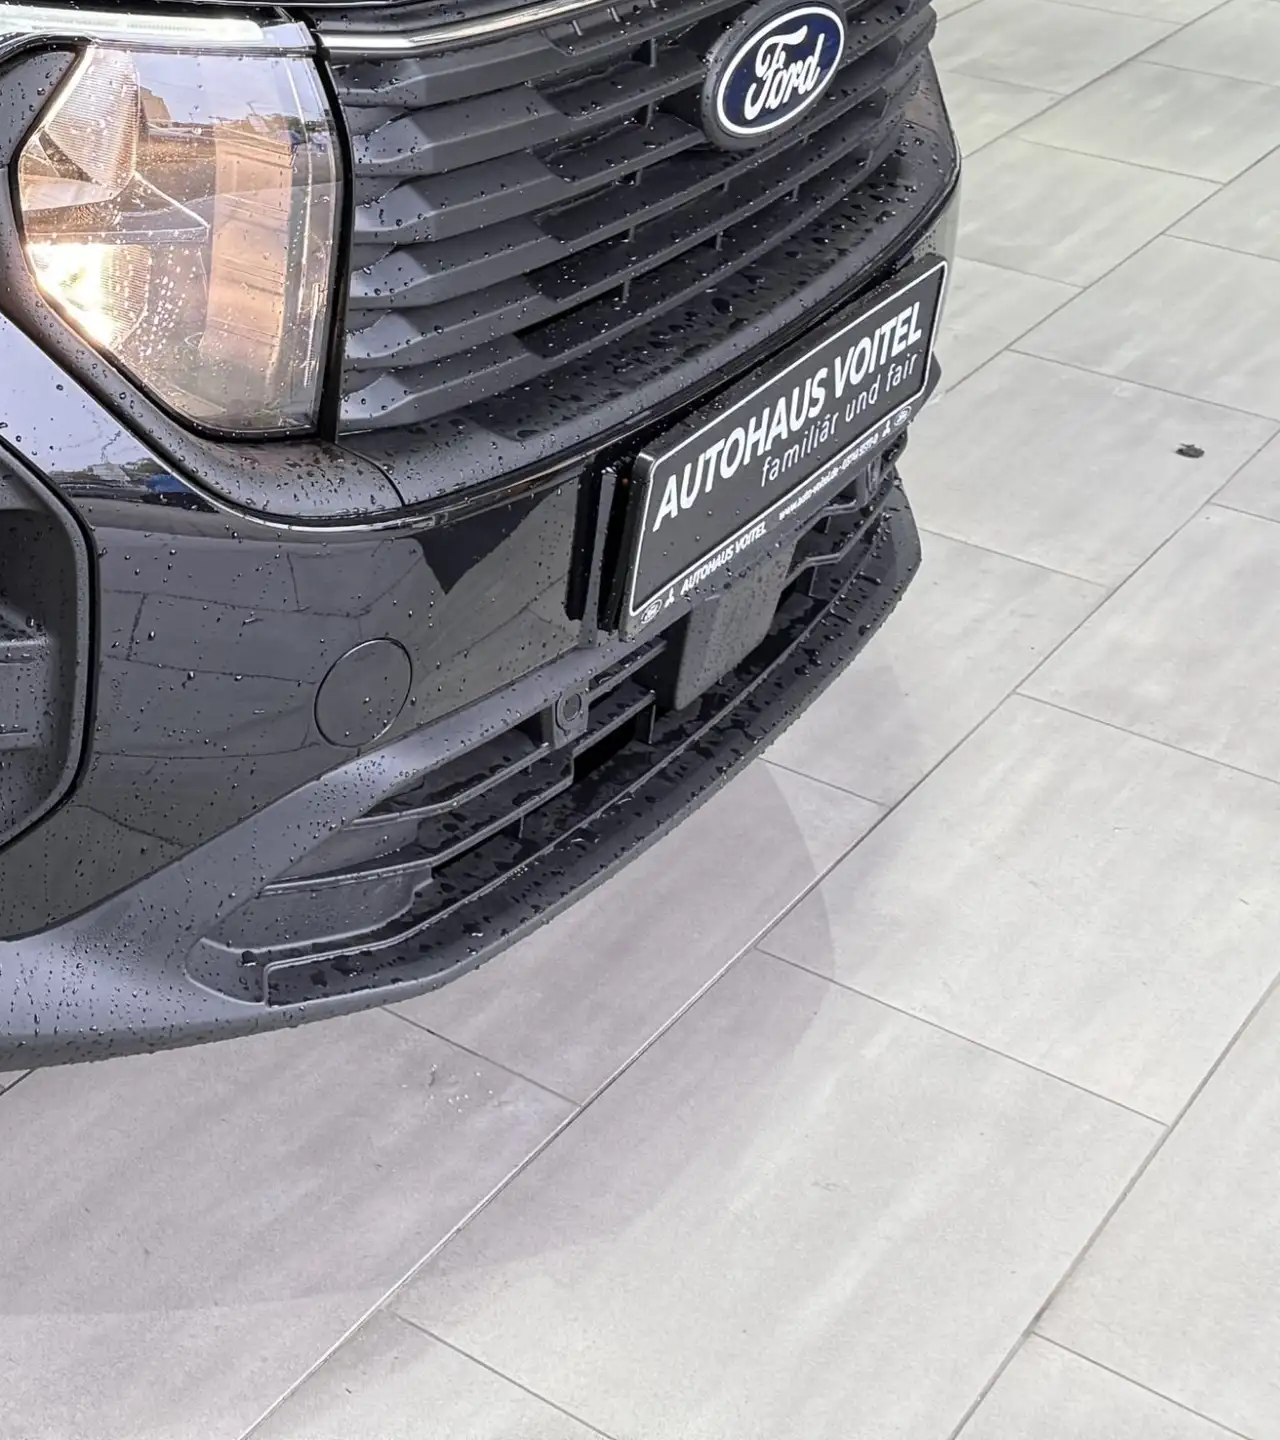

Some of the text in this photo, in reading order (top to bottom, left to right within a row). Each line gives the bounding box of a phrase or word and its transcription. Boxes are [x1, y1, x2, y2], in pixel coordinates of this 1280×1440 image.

[743, 24, 826, 121] Ford
[652, 301, 922, 532] AUTOHAUS VOITEL
[760, 407, 840, 487] familiär
[845, 381, 878, 423] und
[886, 352, 919, 393] fair
[680, 544, 735, 595] AUTOHAUS
